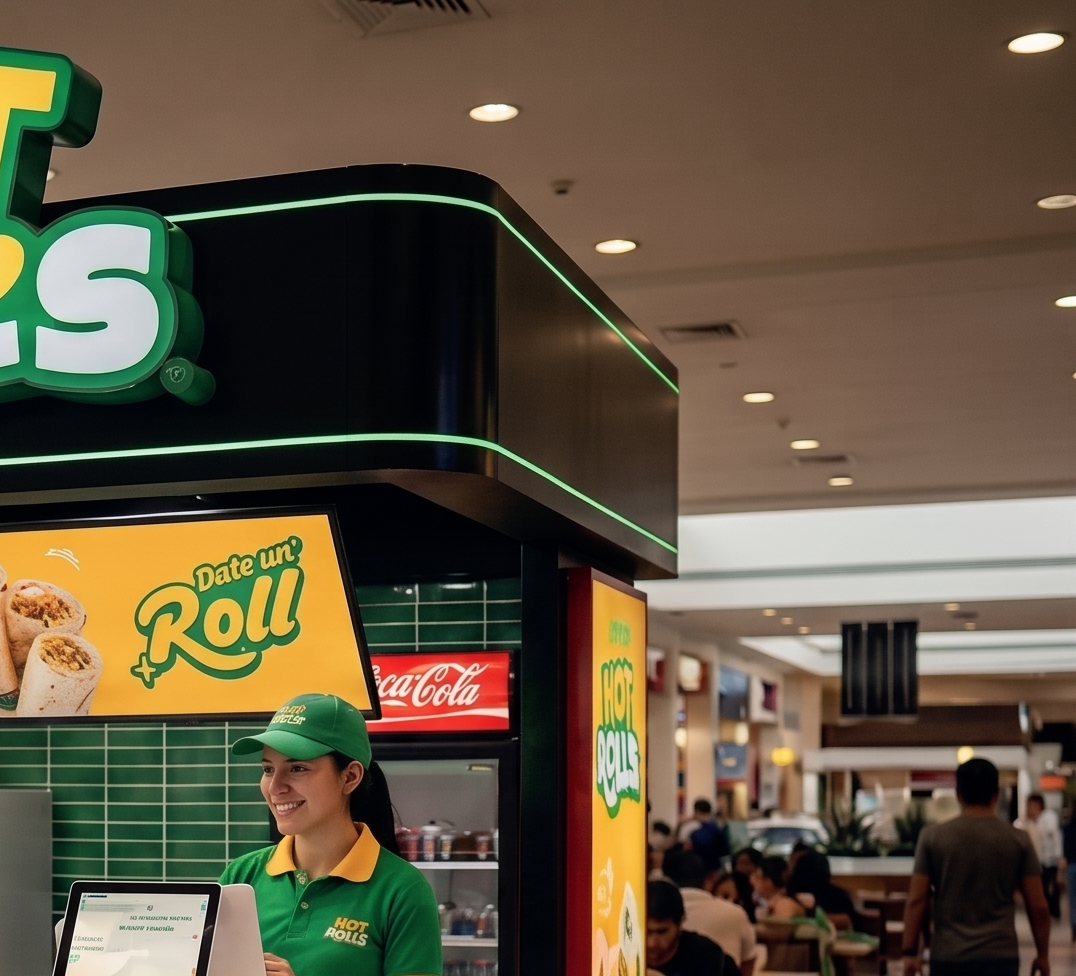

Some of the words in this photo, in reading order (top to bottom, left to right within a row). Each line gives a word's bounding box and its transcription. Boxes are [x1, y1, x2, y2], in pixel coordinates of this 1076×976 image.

[196, 557, 254, 592] Date
[138, 568, 299, 671] Roll
[602, 663, 633, 732] HOT
[334, 917, 369, 933] HOT
